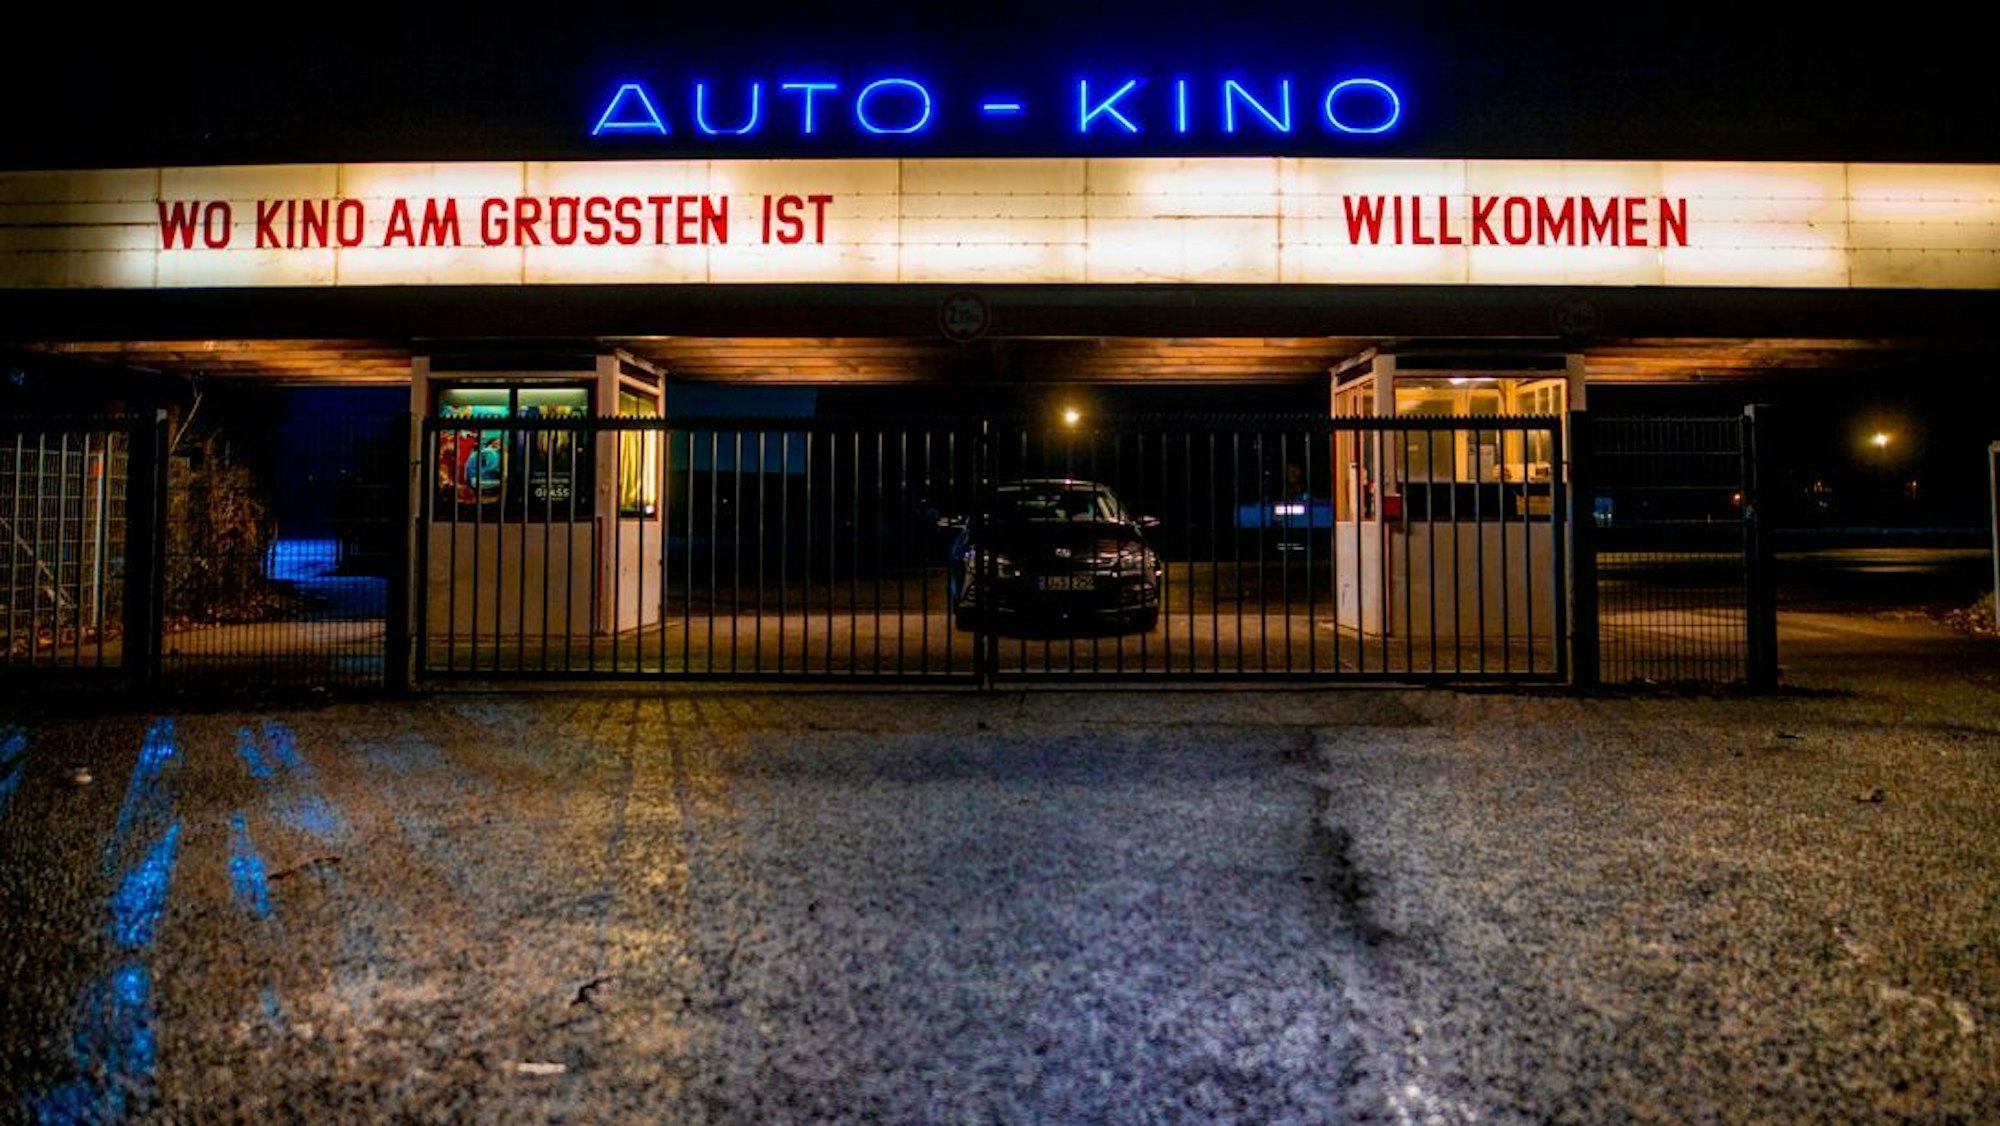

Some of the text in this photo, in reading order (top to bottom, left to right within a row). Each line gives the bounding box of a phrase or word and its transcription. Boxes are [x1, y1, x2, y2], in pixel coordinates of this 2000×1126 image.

[591, 78, 932, 136] AUTO
[1079, 78, 1402, 134] KINO
[158, 194, 833, 250] WO KINO AM GRÖSSTEN IST
[1343, 196, 1688, 247] WILLKOMMEN
